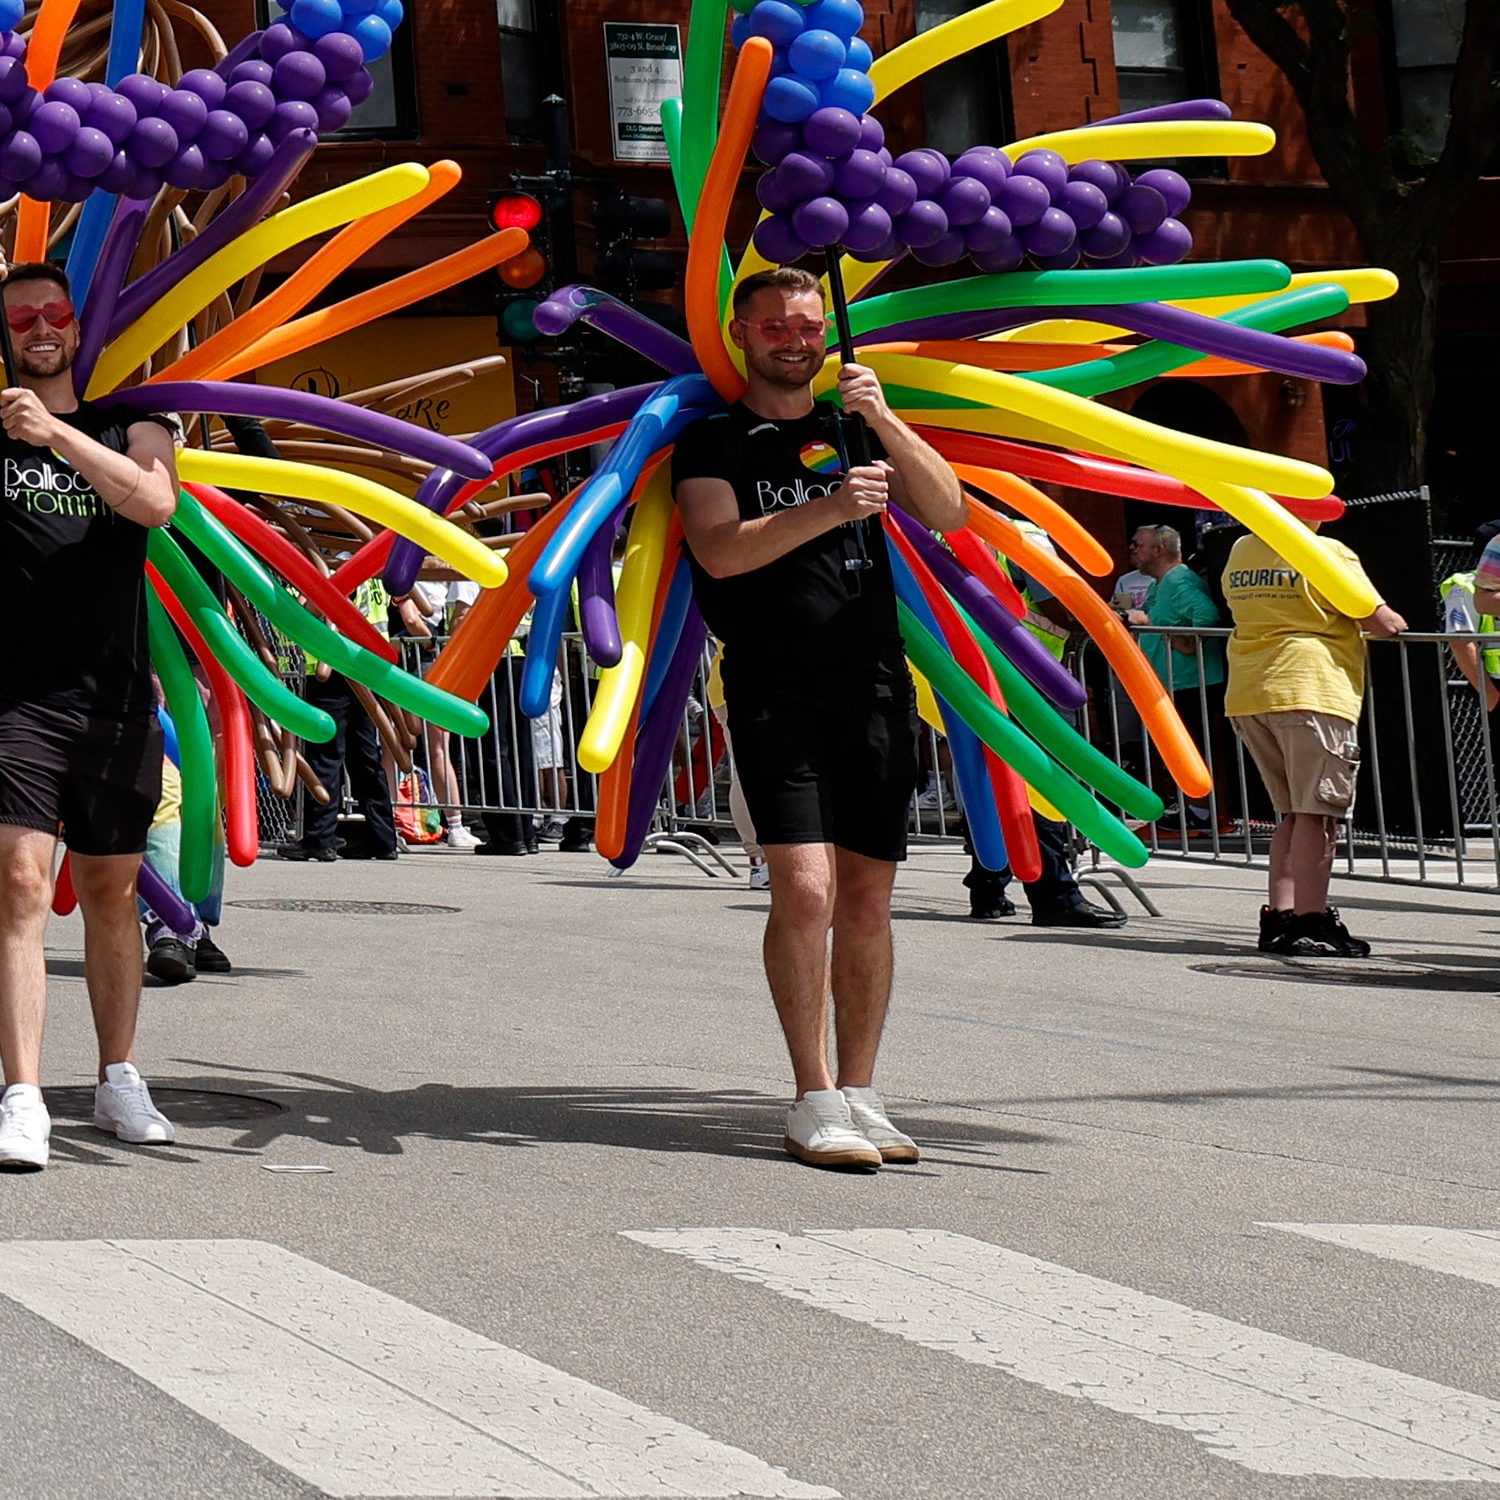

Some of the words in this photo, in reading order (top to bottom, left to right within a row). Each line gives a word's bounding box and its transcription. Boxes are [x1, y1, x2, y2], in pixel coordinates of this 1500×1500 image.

[646, 42, 678, 53] Broadway
[637, 63, 653, 73] and
[616, 106, 661, 118] 773-665-
[4, 458, 94, 493] Balloo
[4, 486, 21, 501] by
[21, 488, 115, 525] Tomm
[1229, 568, 1300, 589] SECURITY
